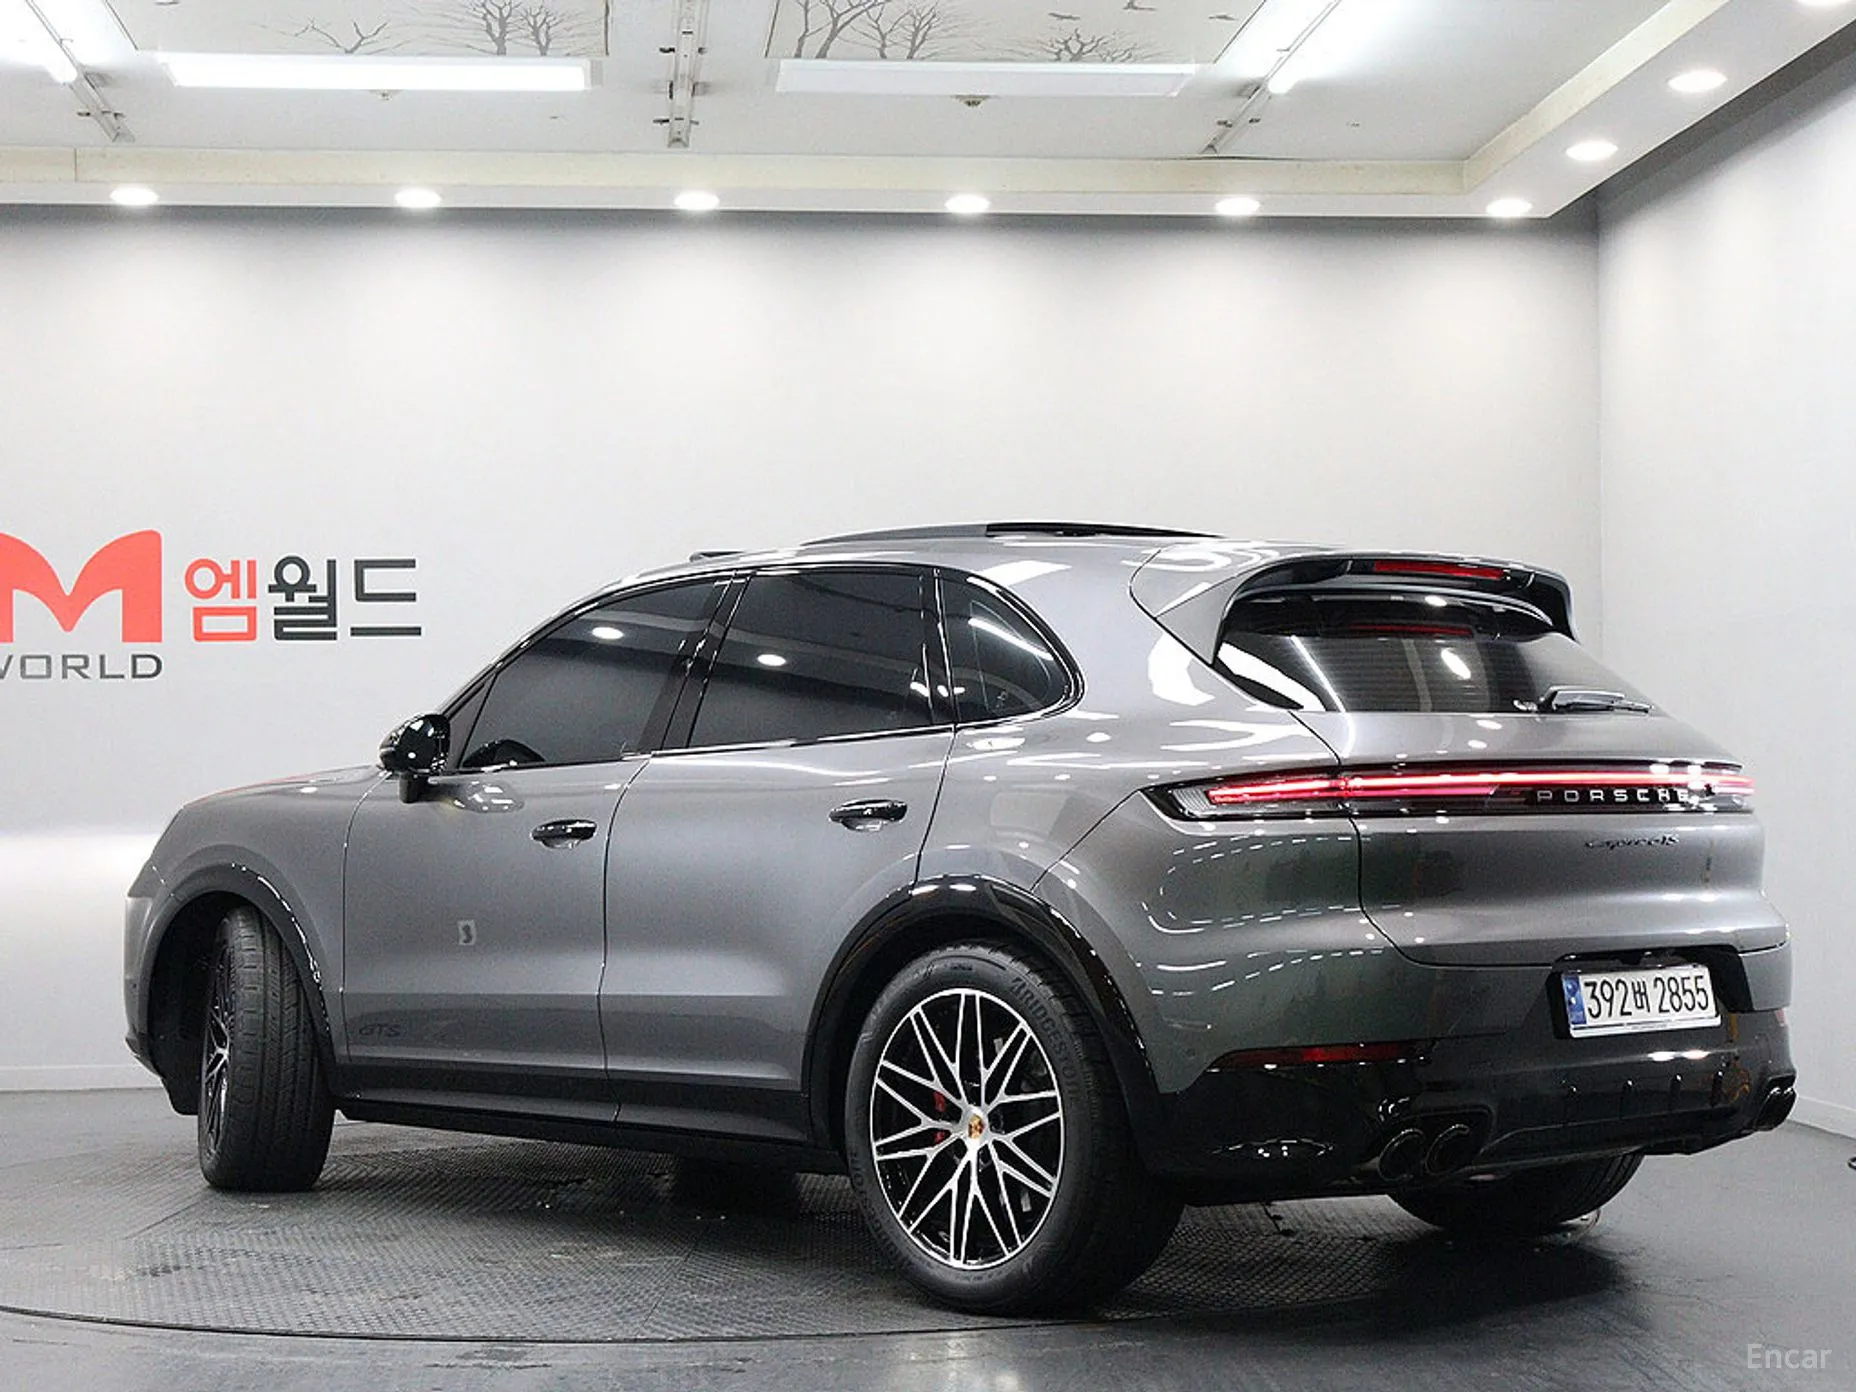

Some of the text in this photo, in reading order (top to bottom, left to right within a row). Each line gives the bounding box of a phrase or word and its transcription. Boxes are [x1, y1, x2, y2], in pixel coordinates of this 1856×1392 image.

[184, 555, 422, 641] 엠월드
[1537, 788, 1690, 803] PORSCHE
[1584, 976, 1709, 1018] 392버 2855
[359, 1023, 405, 1038] GTS
